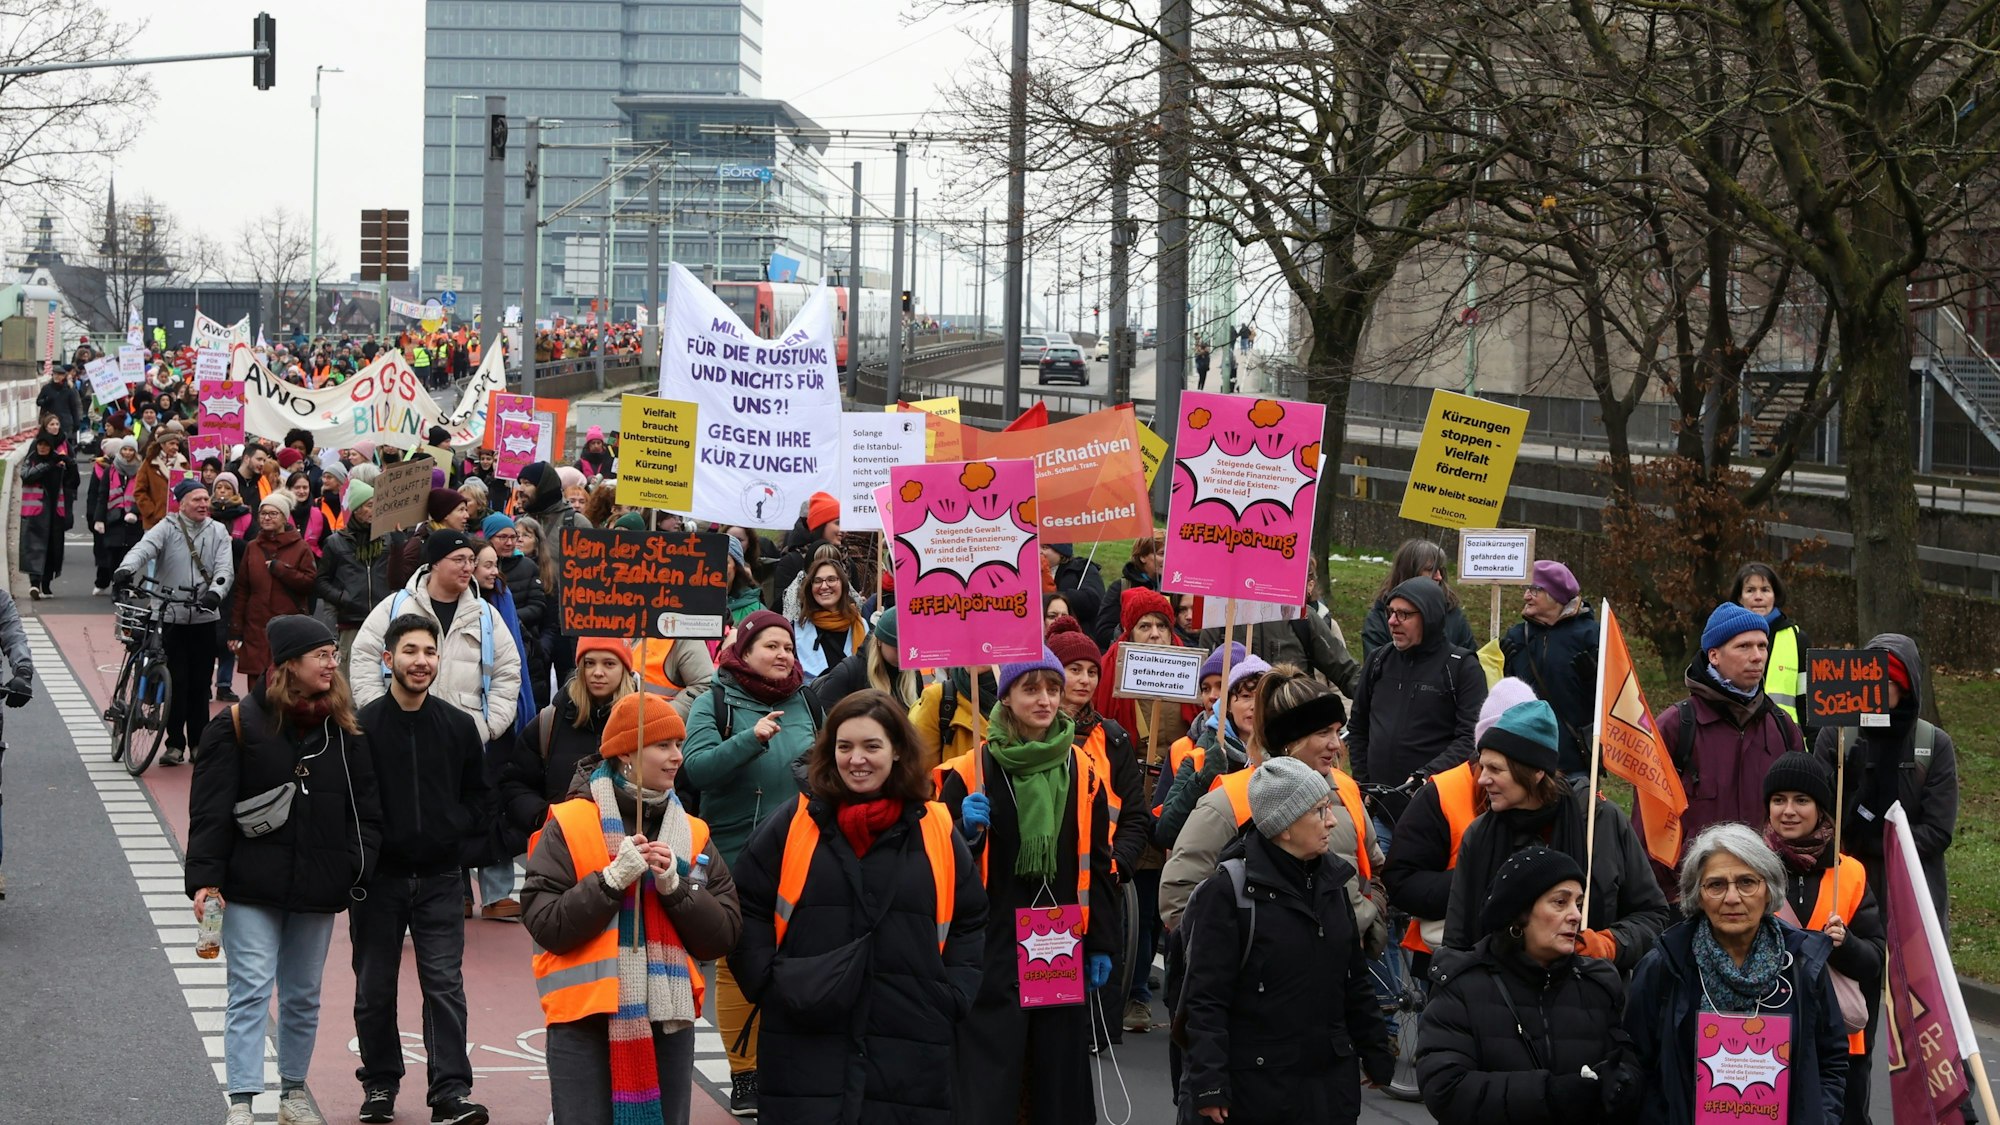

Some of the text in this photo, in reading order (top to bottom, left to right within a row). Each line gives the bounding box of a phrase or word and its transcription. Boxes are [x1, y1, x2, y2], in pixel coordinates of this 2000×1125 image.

[202, 323, 231, 338] AWO
[687, 334, 717, 358] FÜR
[723, 343, 750, 362] DIE
[351, 362, 416, 402] OGS
[692, 362, 824, 390] UND NICHTS FÜR
[244, 362, 316, 416] AWO
[643, 407, 676, 419] Vielfalt
[733, 395, 789, 415] UNS?!
[935, 408, 956, 416] stark
[642, 420, 678, 432] braucht
[1441, 409, 1511, 435] Kürzungen
[623, 432, 690, 448] Unterstützung
[708, 423, 811, 448] GEGEN IHRE
[853, 429, 882, 438] Solange
[1440, 428, 1492, 448] stoppen
[646, 448, 672, 458] keine
[700, 445, 818, 474] KÜRZUNGEN!
[1141, 445, 1158, 464] Räume
[1445, 446, 1490, 466] Vielfalt
[635, 460, 678, 473] Kürzung!
[1055, 466, 1079, 474] Schwul.
[1211, 468, 1297, 483] Sinkende Finanzierung:
[1216, 459, 1254, 470] Steigende
[1256, 463, 1281, 472] Gewalt
[1436, 462, 1488, 483] fördern!
[643, 477, 663, 485] bleibt
[1247, 481, 1280, 490] Existenz-
[1413, 481, 1498, 508] NRW bleibt sozial!
[1042, 503, 1136, 527] Geschichte!
[936, 528, 973, 536] Steigende
[967, 535, 1018, 544] Finanzierung:
[1180, 523, 1297, 559] #FEMpörung
[562, 529, 706, 563] Wenn der Staat
[1467, 540, 1524, 548] Sozialkürzungen
[689, 560, 727, 587] die
[563, 584, 683, 608] Menschen die
[909, 590, 1028, 620] #FEMpörung
[564, 606, 636, 637] Rechnung
[1129, 654, 1196, 667] Sozialkürzungen
[1811, 658, 1846, 683] NRW
[1132, 668, 1175, 678] gefährden
[1136, 679, 1184, 690] Demokratie
[1704, 1100, 1779, 1120] #FEMpörung
